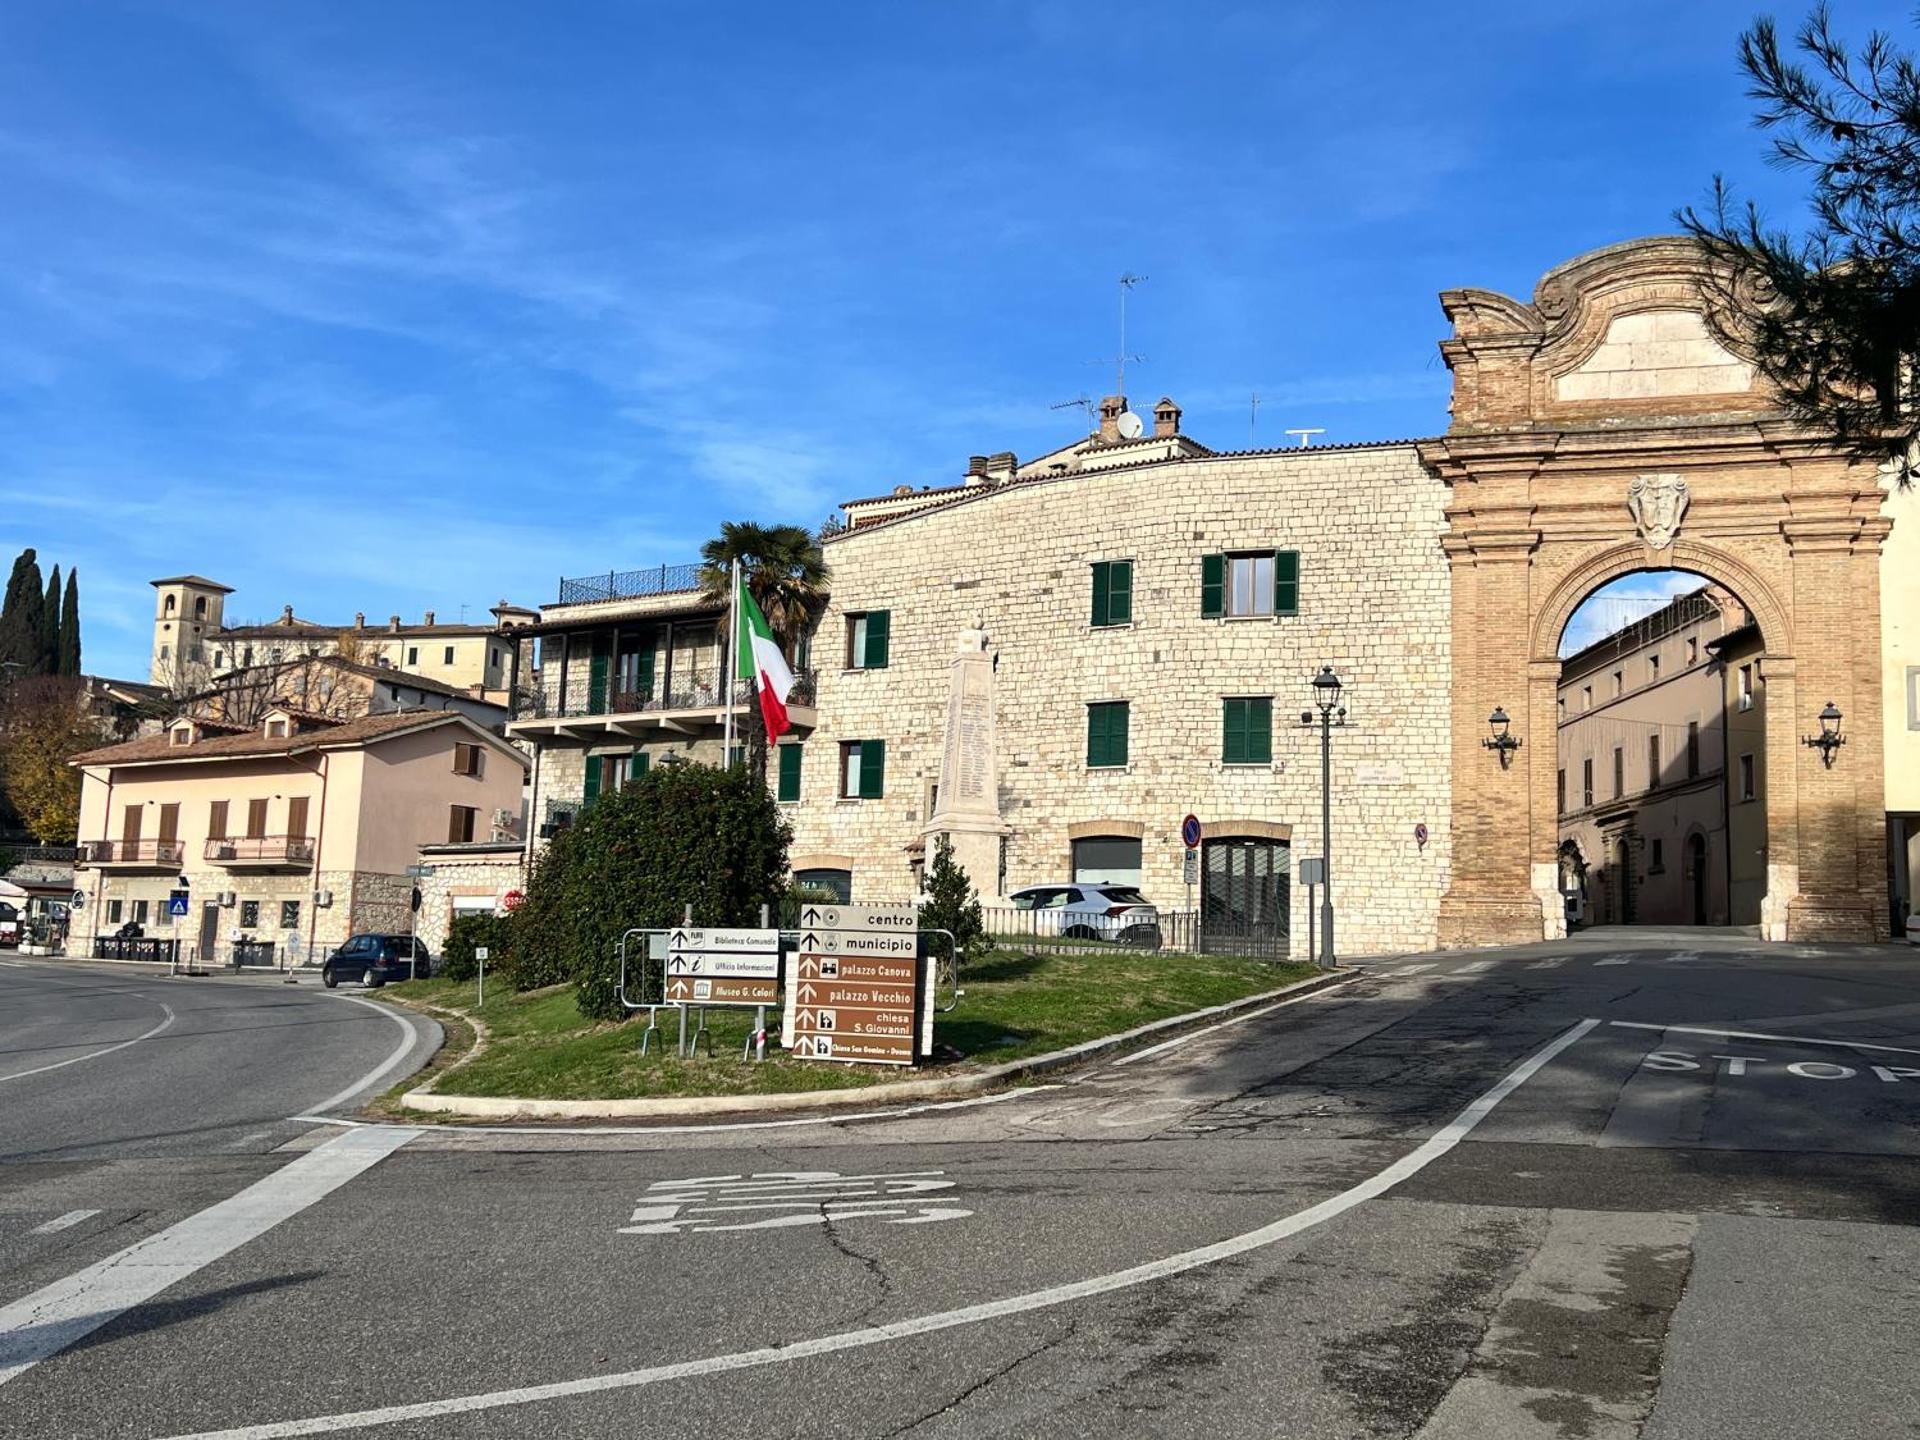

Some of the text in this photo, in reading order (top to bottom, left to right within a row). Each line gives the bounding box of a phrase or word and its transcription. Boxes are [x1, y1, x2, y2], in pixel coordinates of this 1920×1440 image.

[868, 914, 913, 926] centro
[846, 939, 912, 952] municipio
[842, 963, 911, 977] palazzo Canova
[716, 987, 741, 997] Museo
[830, 988, 911, 1004] palazzo Vecchio
[876, 1013, 909, 1023] chiesa
